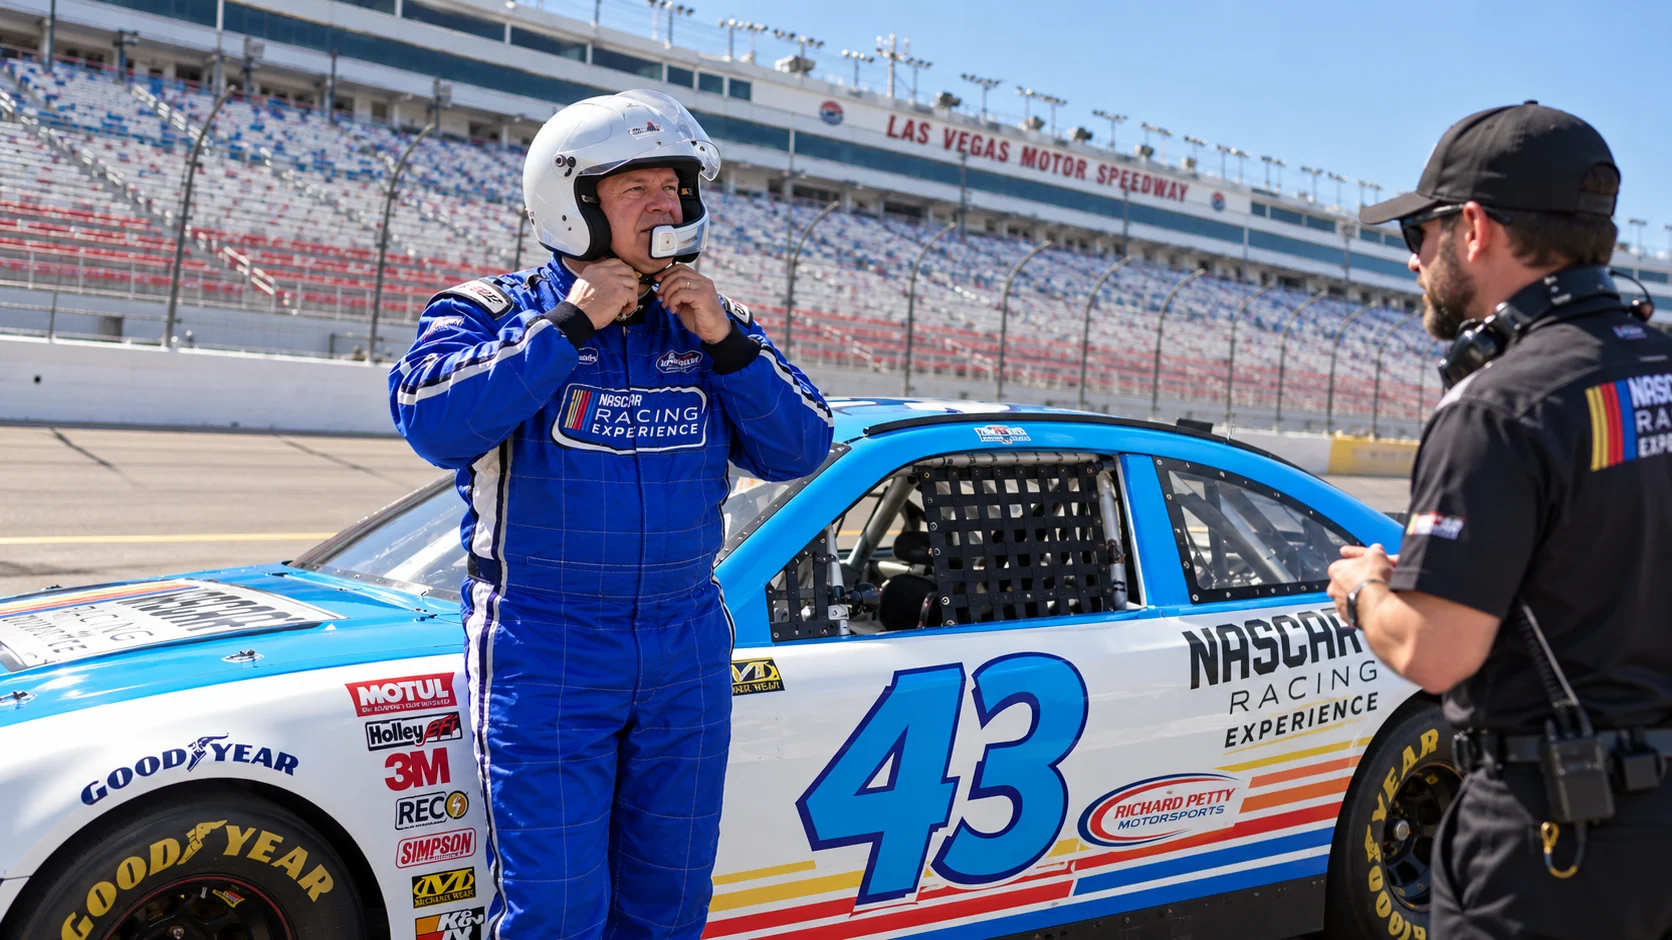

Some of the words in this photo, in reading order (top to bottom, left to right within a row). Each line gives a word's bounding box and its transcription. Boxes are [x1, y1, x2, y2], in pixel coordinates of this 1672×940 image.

[886, 115, 931, 145] LAS
[943, 127, 1010, 163] VEGAS
[1020, 146, 1087, 180] MOTOR
[1096, 164, 1190, 202] SPEEDWAY
[595, 407, 699, 424] RACING
[598, 394, 643, 408] NASCAR
[591, 423, 699, 439] EXPERIENCE
[1635, 407, 1672, 433] RA
[1181, 607, 1363, 690] NASCAR
[357, 679, 449, 706] MOTUL
[1229, 660, 1377, 715] RACING
[368, 722, 424, 745] Holley
[1224, 692, 1379, 748] EXPERIENCE
[384, 747, 451, 791] 3M
[795, 652, 1089, 906] 43
[1114, 796, 1184, 819] RICHARD
[1185, 788, 1236, 808] PETTY
[1117, 805, 1225, 831] MOTORSPORTS
[400, 832, 473, 864] SIMPSON
